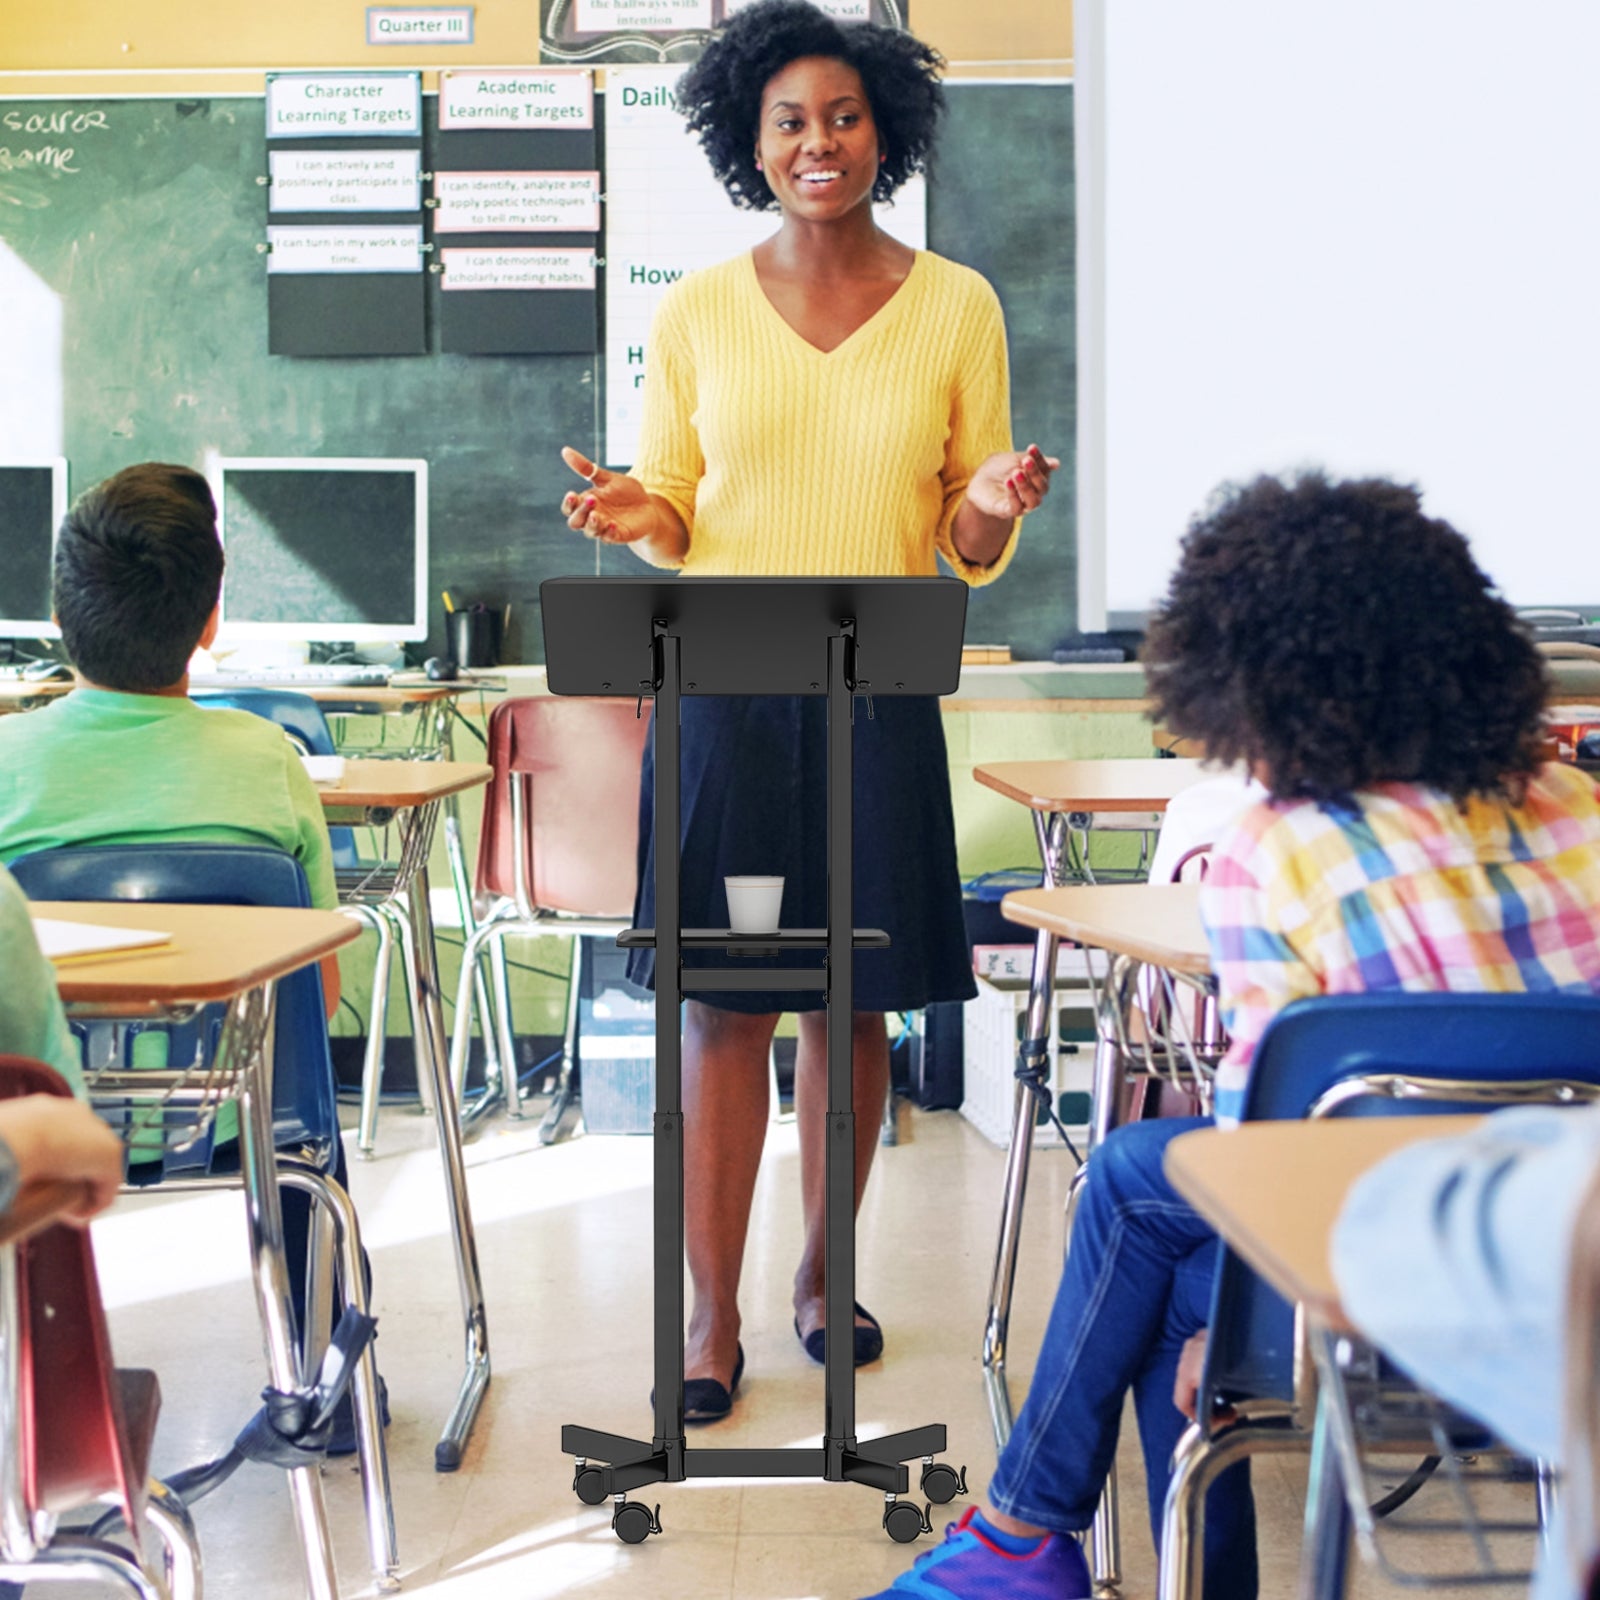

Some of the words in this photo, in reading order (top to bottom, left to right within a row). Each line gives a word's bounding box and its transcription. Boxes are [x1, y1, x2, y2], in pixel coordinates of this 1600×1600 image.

[379, 19, 442, 34] Quarter
[447, 19, 463, 32] III
[617, 15, 672, 25] intention
[304, 84, 383, 98] Character
[477, 80, 556, 95] Academic
[277, 109, 346, 124] Learning
[353, 107, 412, 123] Targets
[449, 104, 519, 119] Learning
[525, 103, 584, 120] Targets
[302, 160, 323, 170] can
[326, 159, 370, 171] actively
[373, 159, 394, 169] and
[278, 176, 333, 190] positively
[337, 175, 398, 189] participate
[402, 175, 413, 187] in
[449, 181, 469, 191] can
[523, 178, 566, 193] analyze
[569, 179, 591, 189] and
[449, 197, 480, 209] apply
[484, 196, 518, 208] poetic
[522, 196, 585, 208] techniques
[472, 213, 484, 223] to
[487, 213, 505, 223] tell
[509, 213, 526, 224] my
[529, 213, 562, 224] story.
[282, 238, 303, 248] can
[306, 237, 330, 248] turn
[333, 237, 345, 248] in
[348, 238, 367, 250] my
[369, 236, 397, 247] work
[400, 236, 416, 247] on
[472, 256, 493, 266] can
[496, 254, 570, 266] demonstrate
[448, 271, 498, 284] scholarly
[502, 271, 546, 284] reading
[630, 265, 684, 285] How
